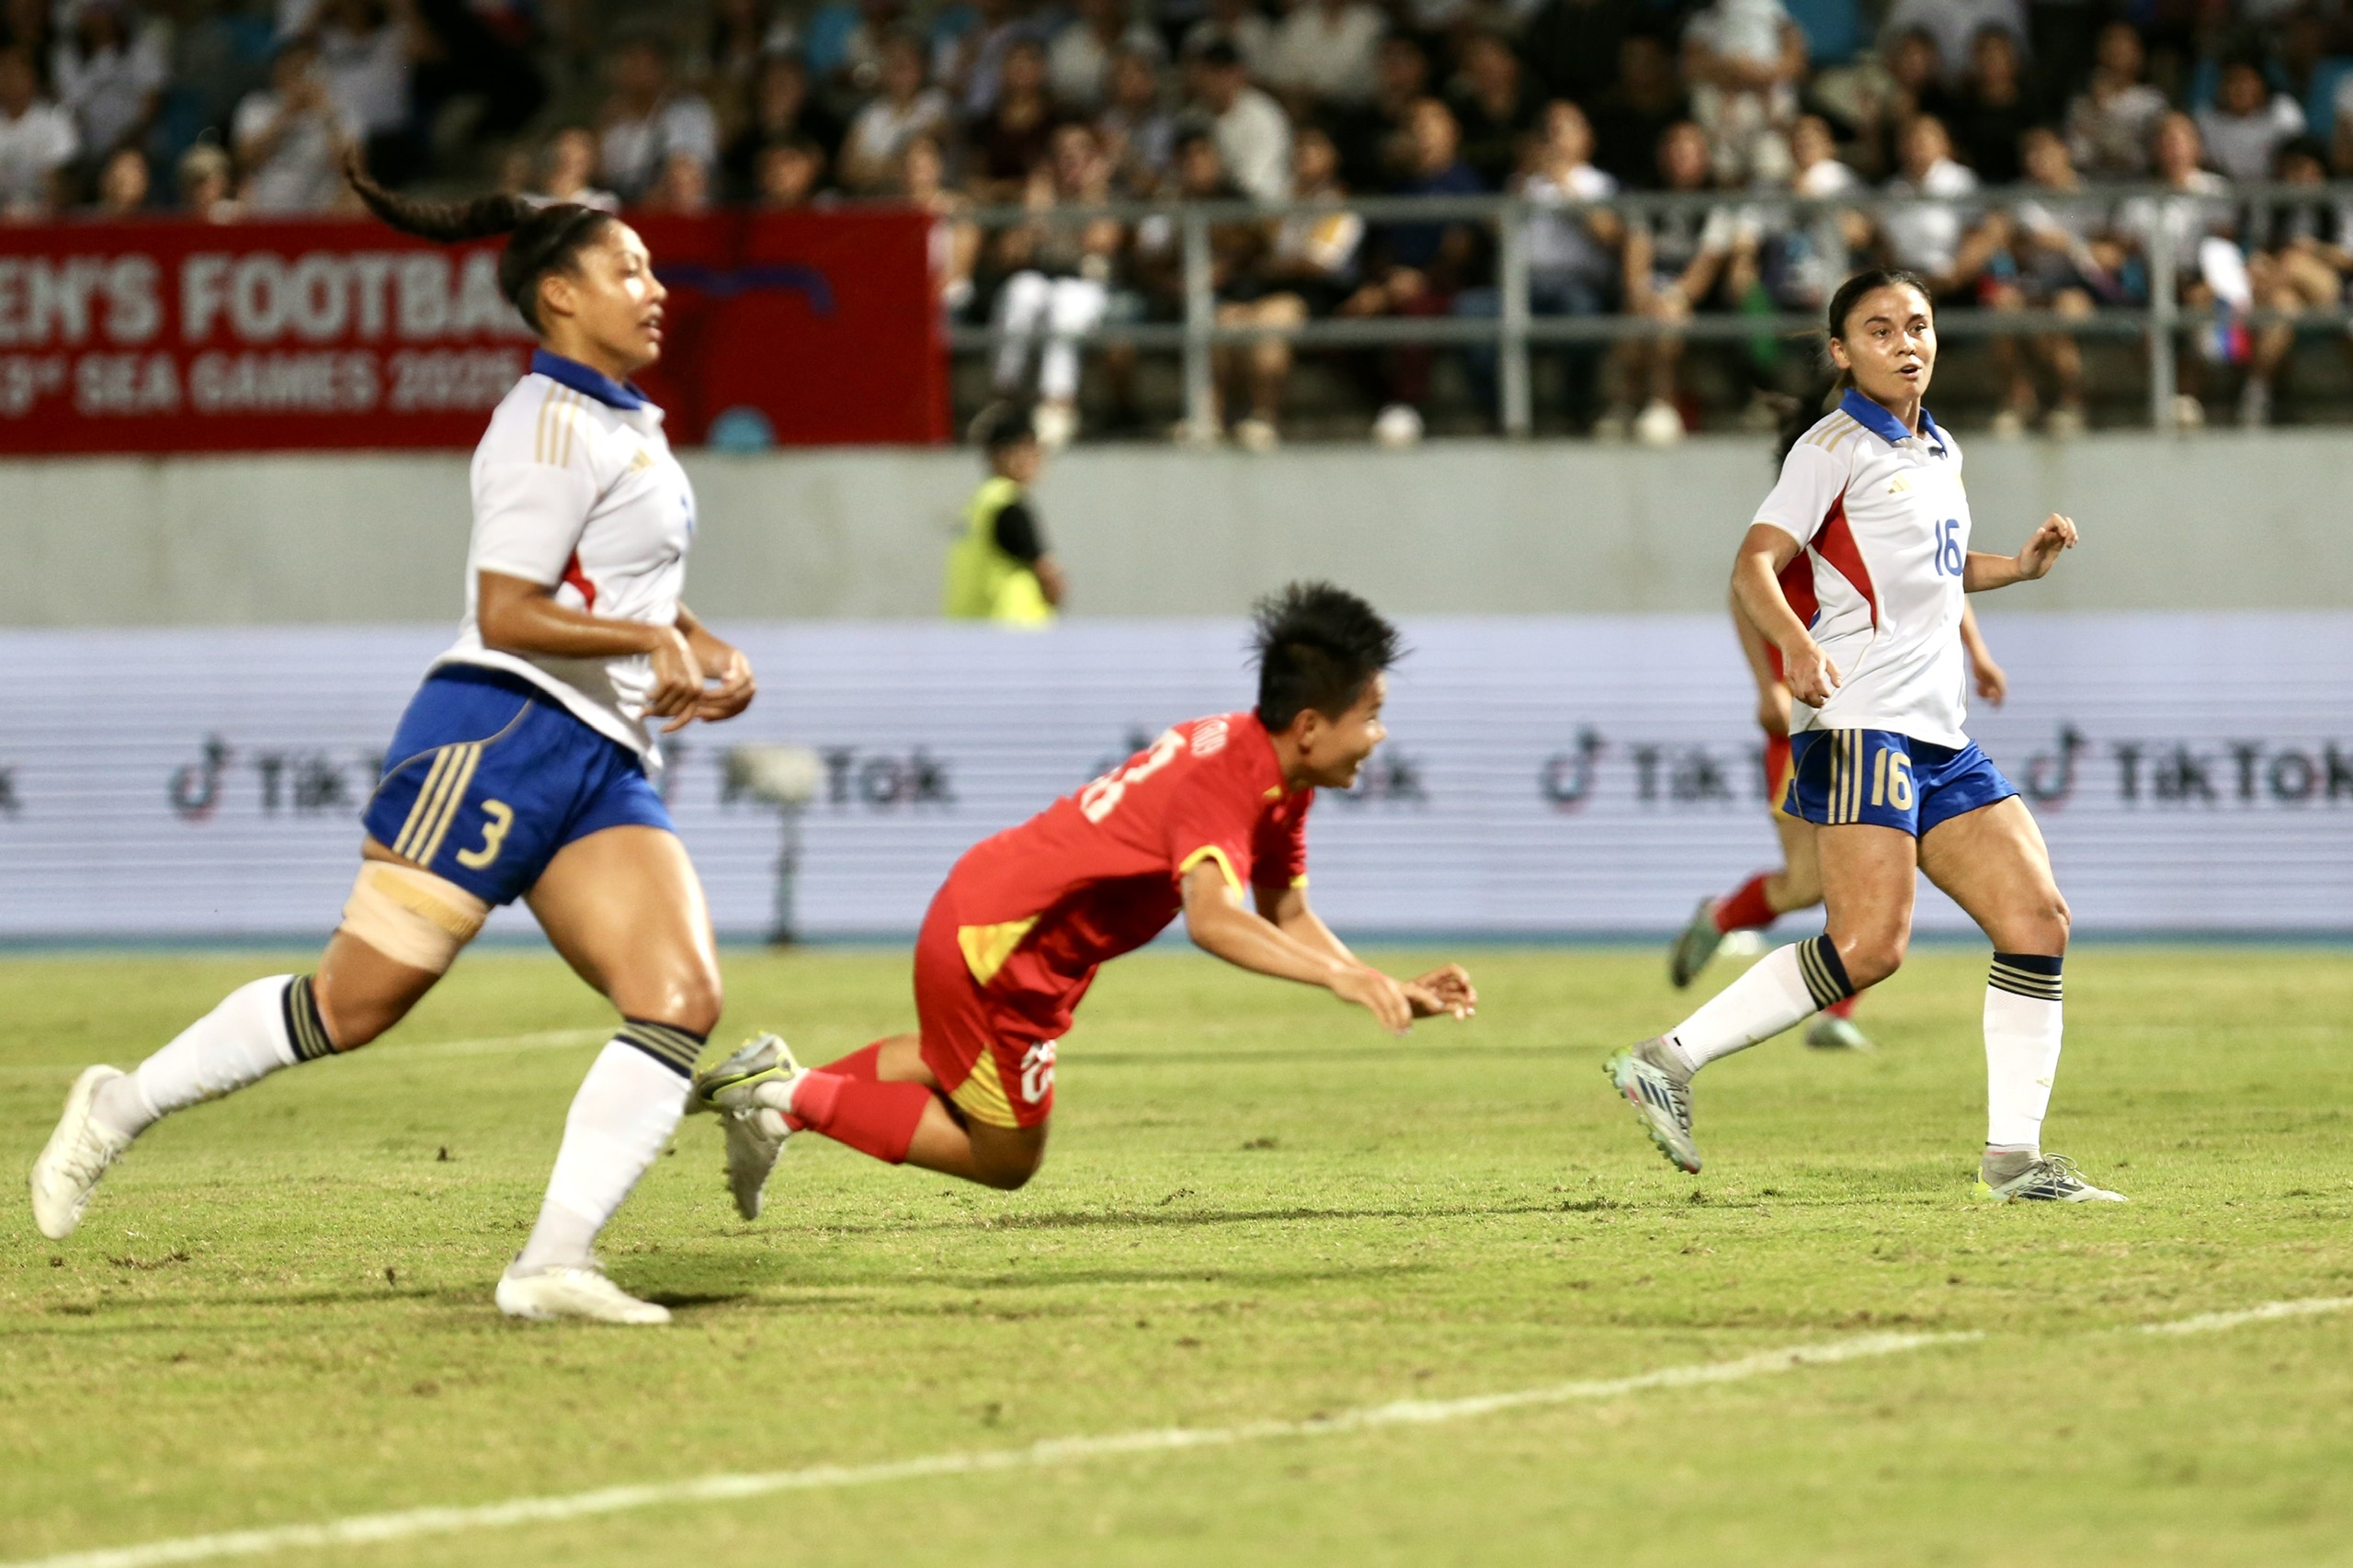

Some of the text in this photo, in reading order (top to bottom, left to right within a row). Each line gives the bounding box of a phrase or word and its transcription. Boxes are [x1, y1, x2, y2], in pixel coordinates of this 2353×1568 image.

[184, 253, 536, 337] FOOTBA
[77, 352, 179, 411] SEA
[191, 351, 374, 411] GAMES
[1934, 518, 1963, 577] 16
[1870, 747, 1914, 812] 16
[456, 799, 515, 869] 3
